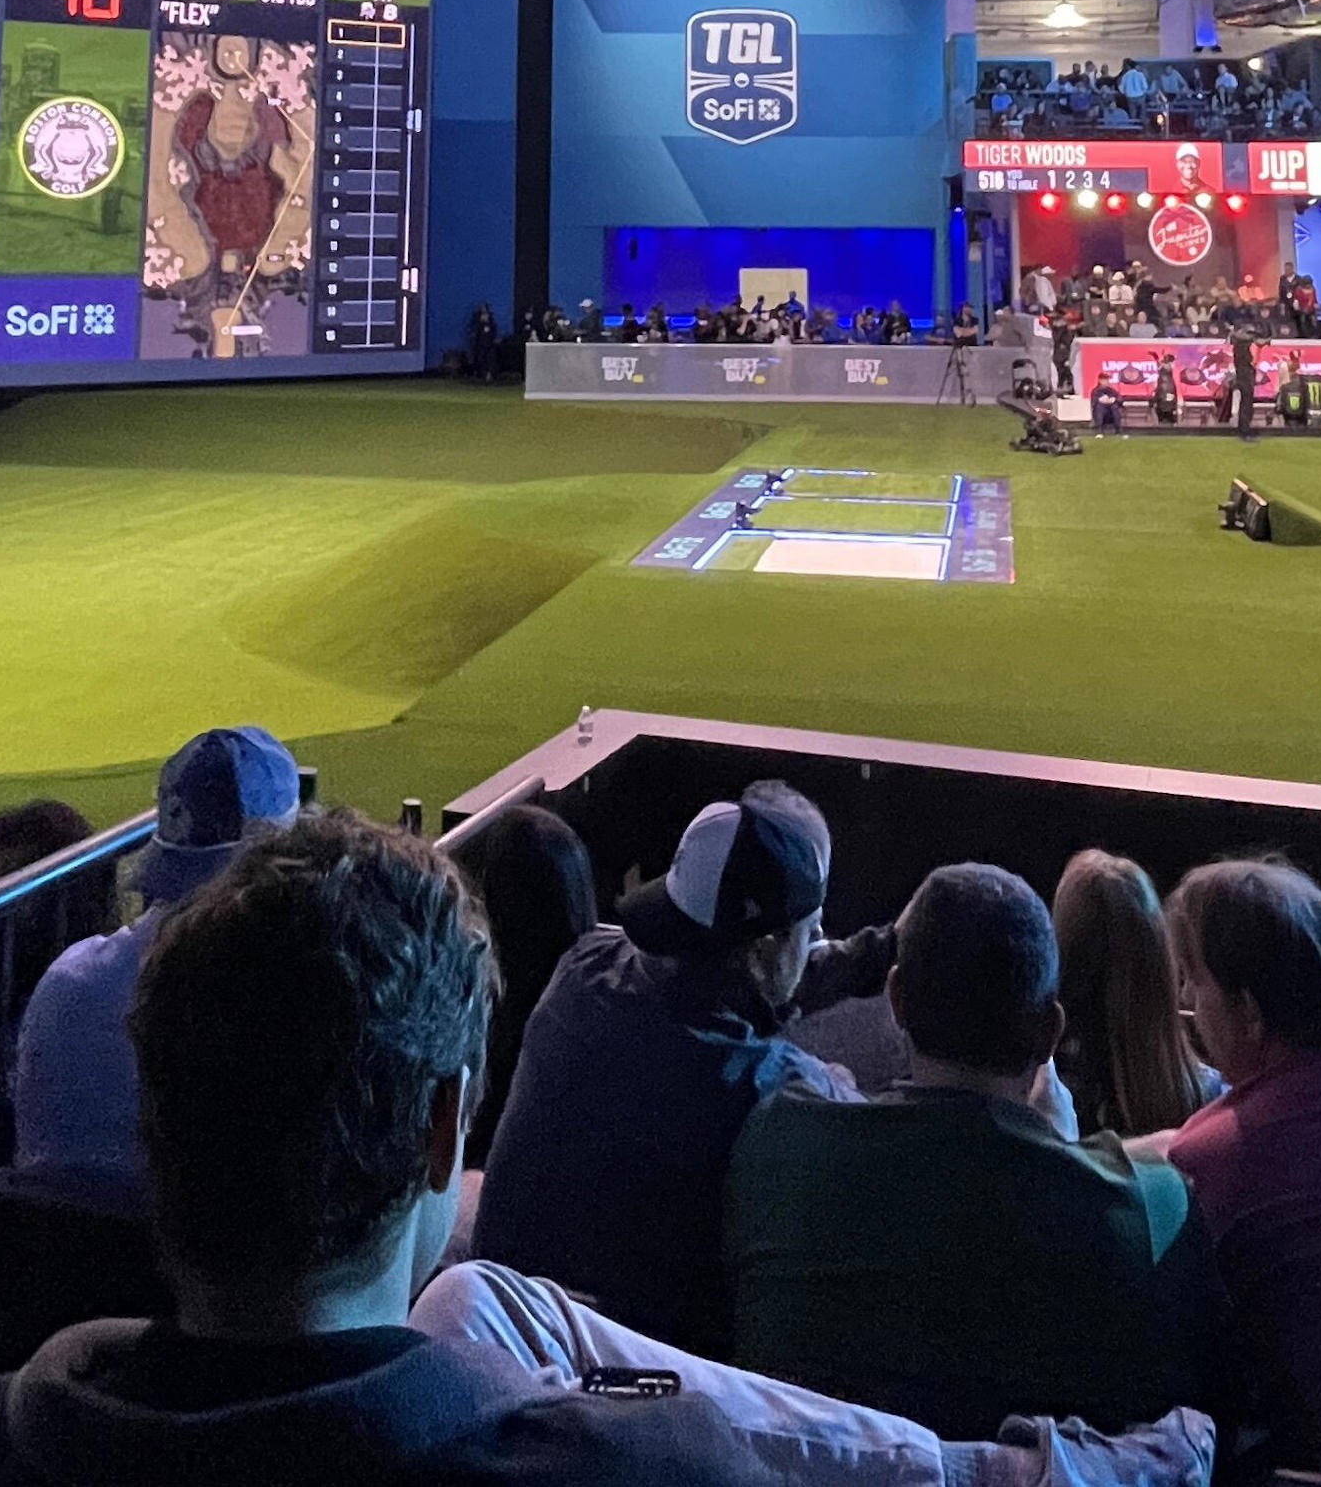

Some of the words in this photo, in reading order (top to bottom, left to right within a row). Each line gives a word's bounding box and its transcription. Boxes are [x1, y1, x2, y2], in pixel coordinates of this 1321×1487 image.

[701, 22, 782, 64] TGL
[703, 98, 754, 121] SoFi
[976, 145, 1022, 165] TIGER
[1025, 145, 1087, 166] WOODS
[1258, 149, 1305, 180] JUP
[1048, 170, 1057, 189] 1
[1066, 171, 1076, 189] 2
[1083, 171, 1093, 189] 3
[1100, 170, 1111, 189] 4
[51, 181, 86, 194] GOLF
[5, 304, 79, 336] SoFi
[602, 357, 639, 370] BEST
[723, 358, 760, 371] BEST
[844, 359, 882, 372] BEST
[604, 367, 636, 382] BUY
[725, 368, 755, 383] BUY
[847, 369, 877, 384] BUY
